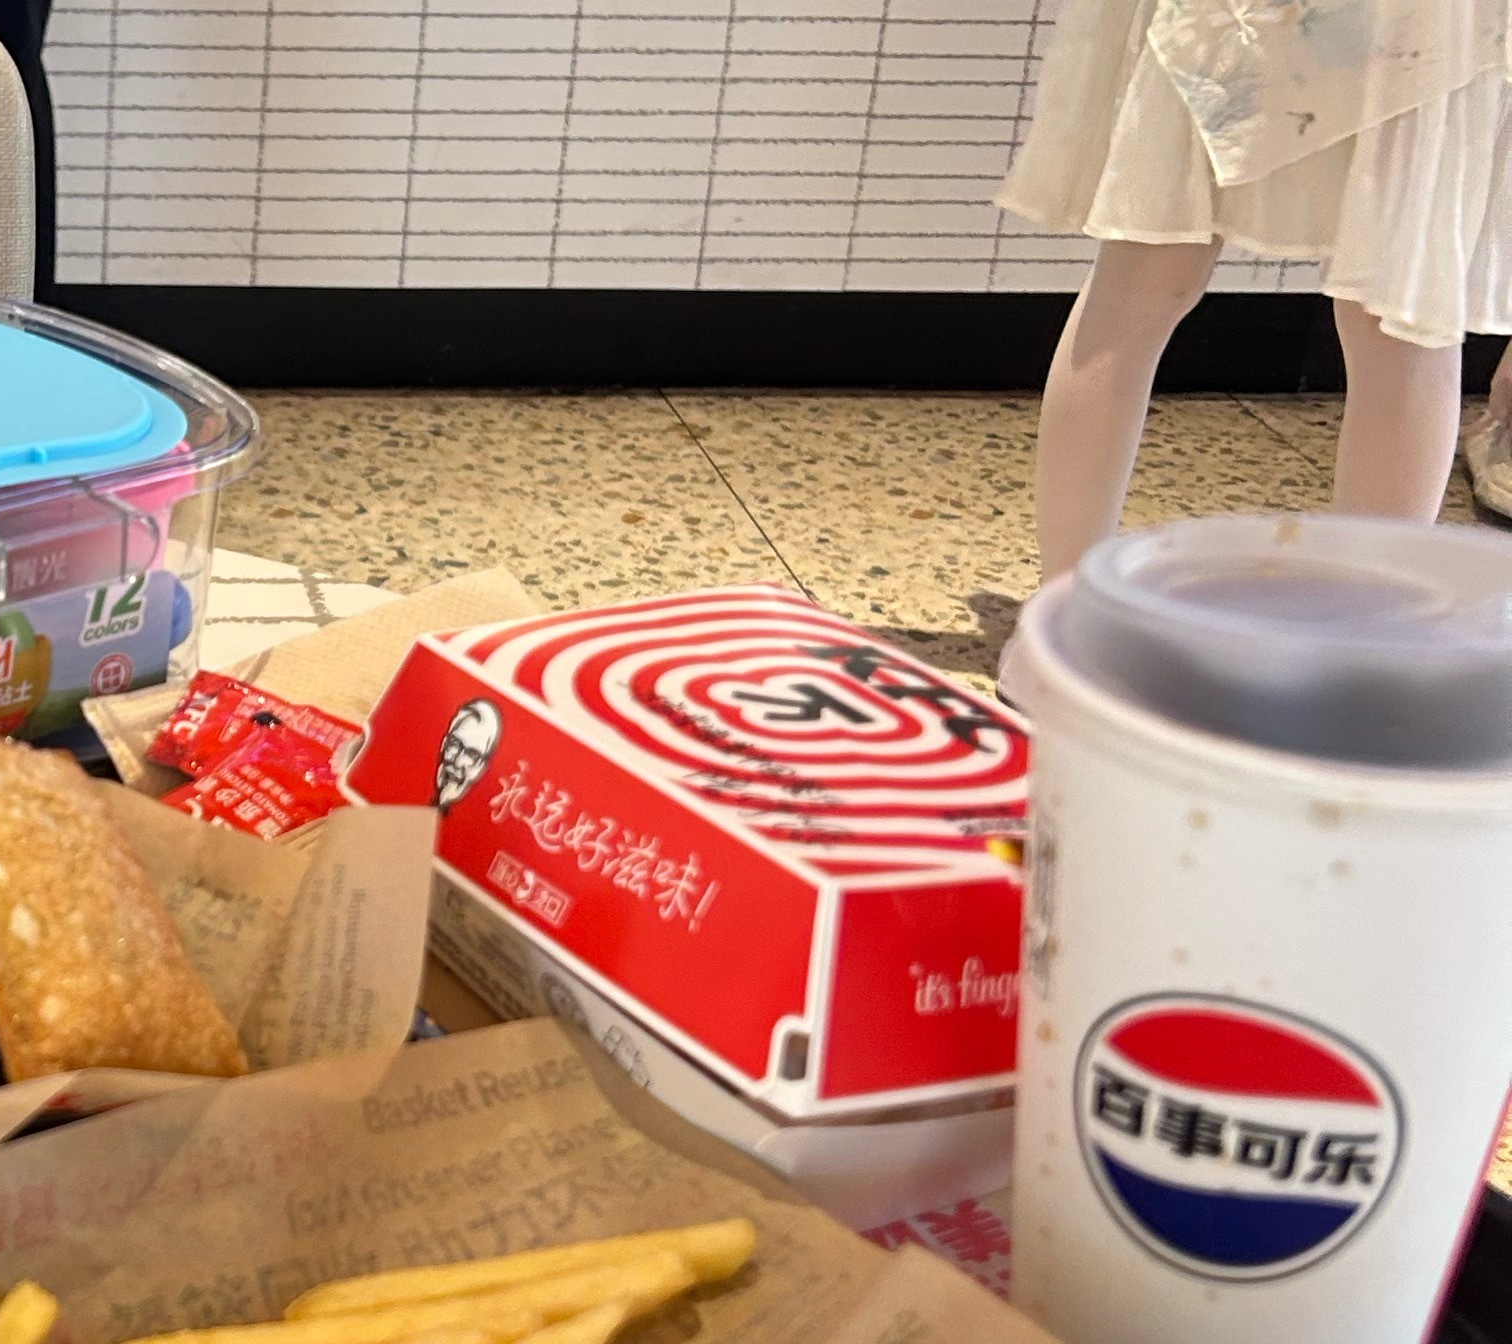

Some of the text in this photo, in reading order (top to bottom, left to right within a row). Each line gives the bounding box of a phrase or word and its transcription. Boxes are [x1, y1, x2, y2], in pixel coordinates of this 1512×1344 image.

[83, 617, 139, 643] colors
[90, 572, 146, 624] 12
[795, 644, 999, 754] KFC
[360, 1057, 587, 1135] Basket Reuse
[1093, 1063, 1379, 1186] 百事可乐
